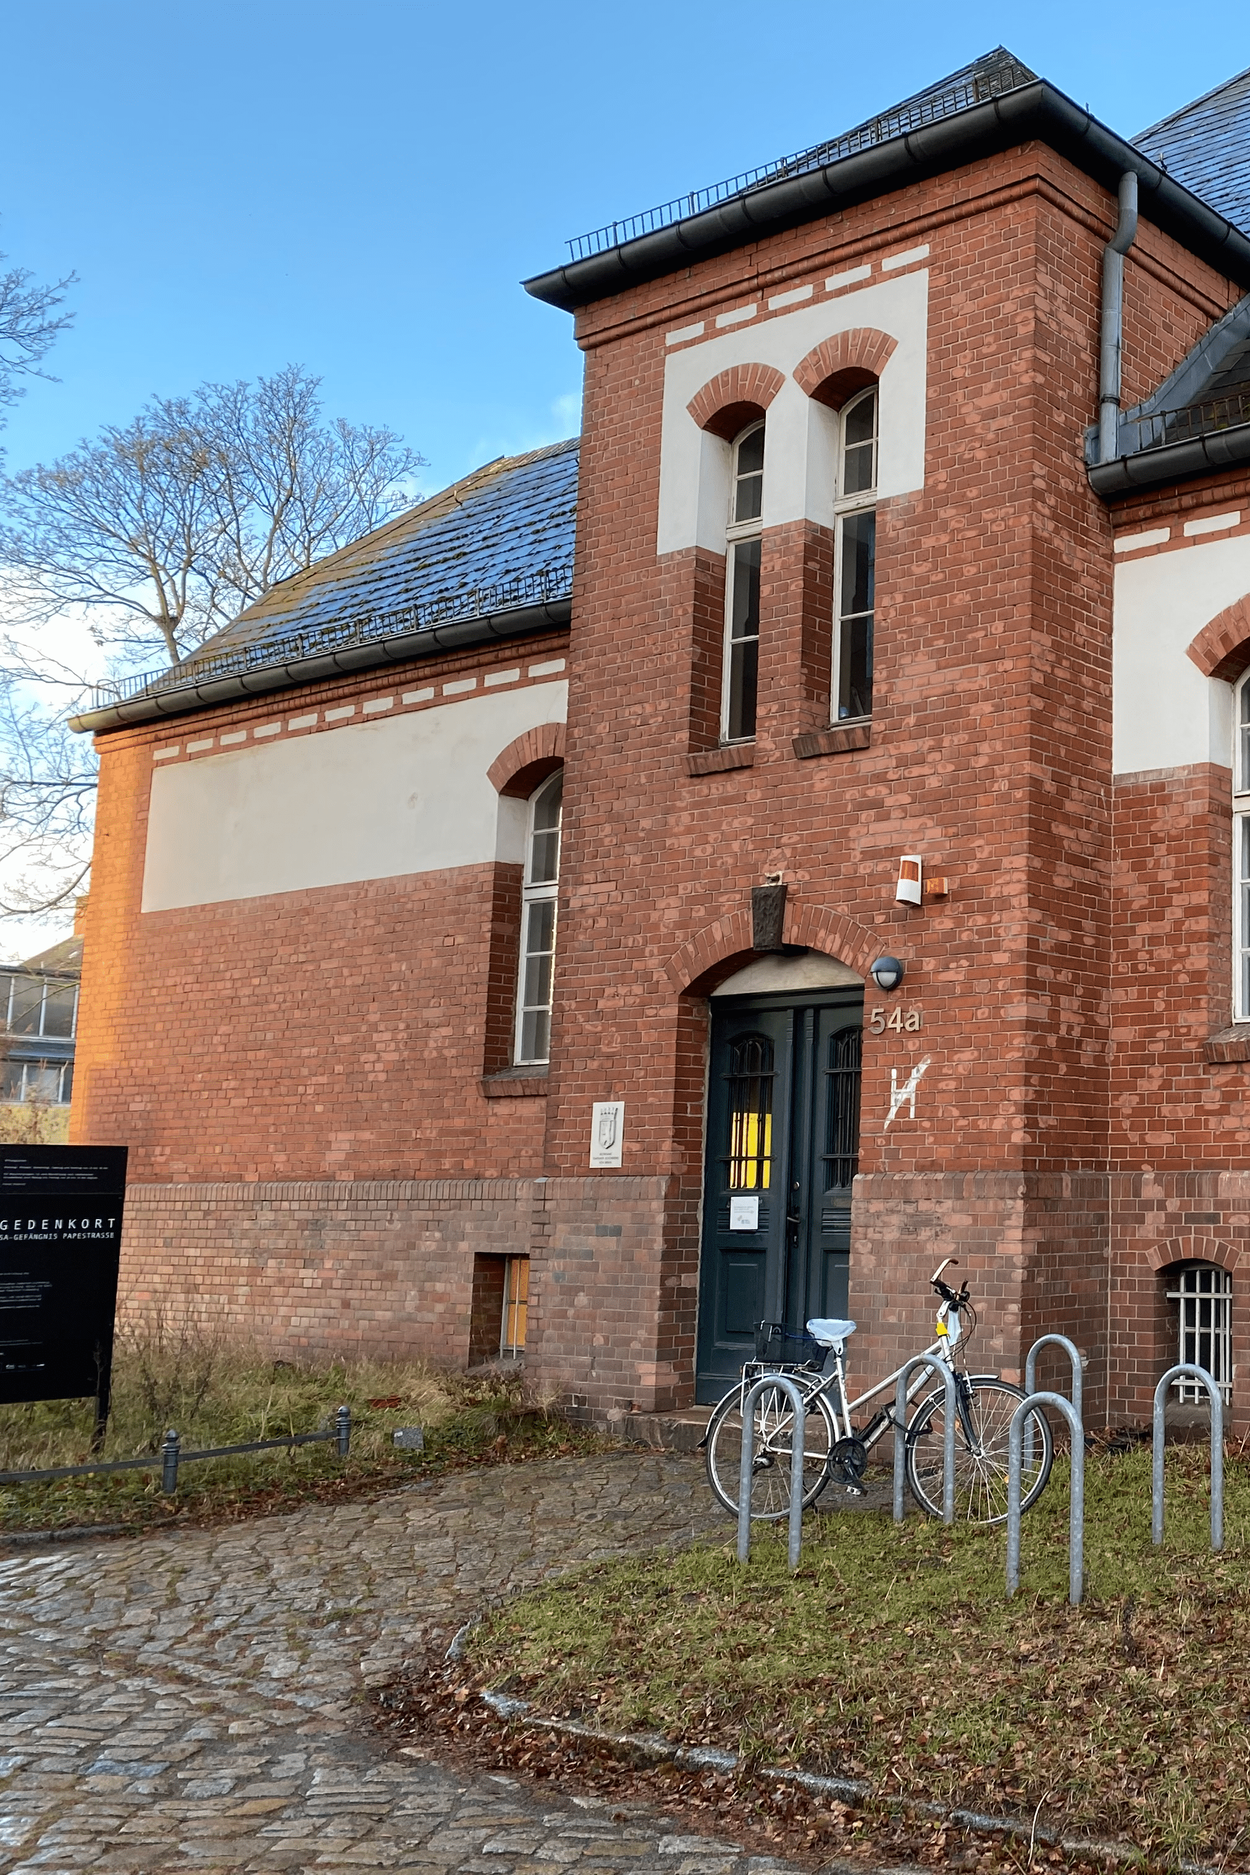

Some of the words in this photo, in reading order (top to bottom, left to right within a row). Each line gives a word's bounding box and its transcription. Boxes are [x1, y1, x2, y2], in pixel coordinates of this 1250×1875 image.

[868, 1006, 922, 1035] 54a
[0, 1218, 116, 1231] GEDENKORT
[0, 1233, 58, 1241] SA-GEFÄNGNIS
[62, 1232, 115, 1240] PAPESTRASSE
